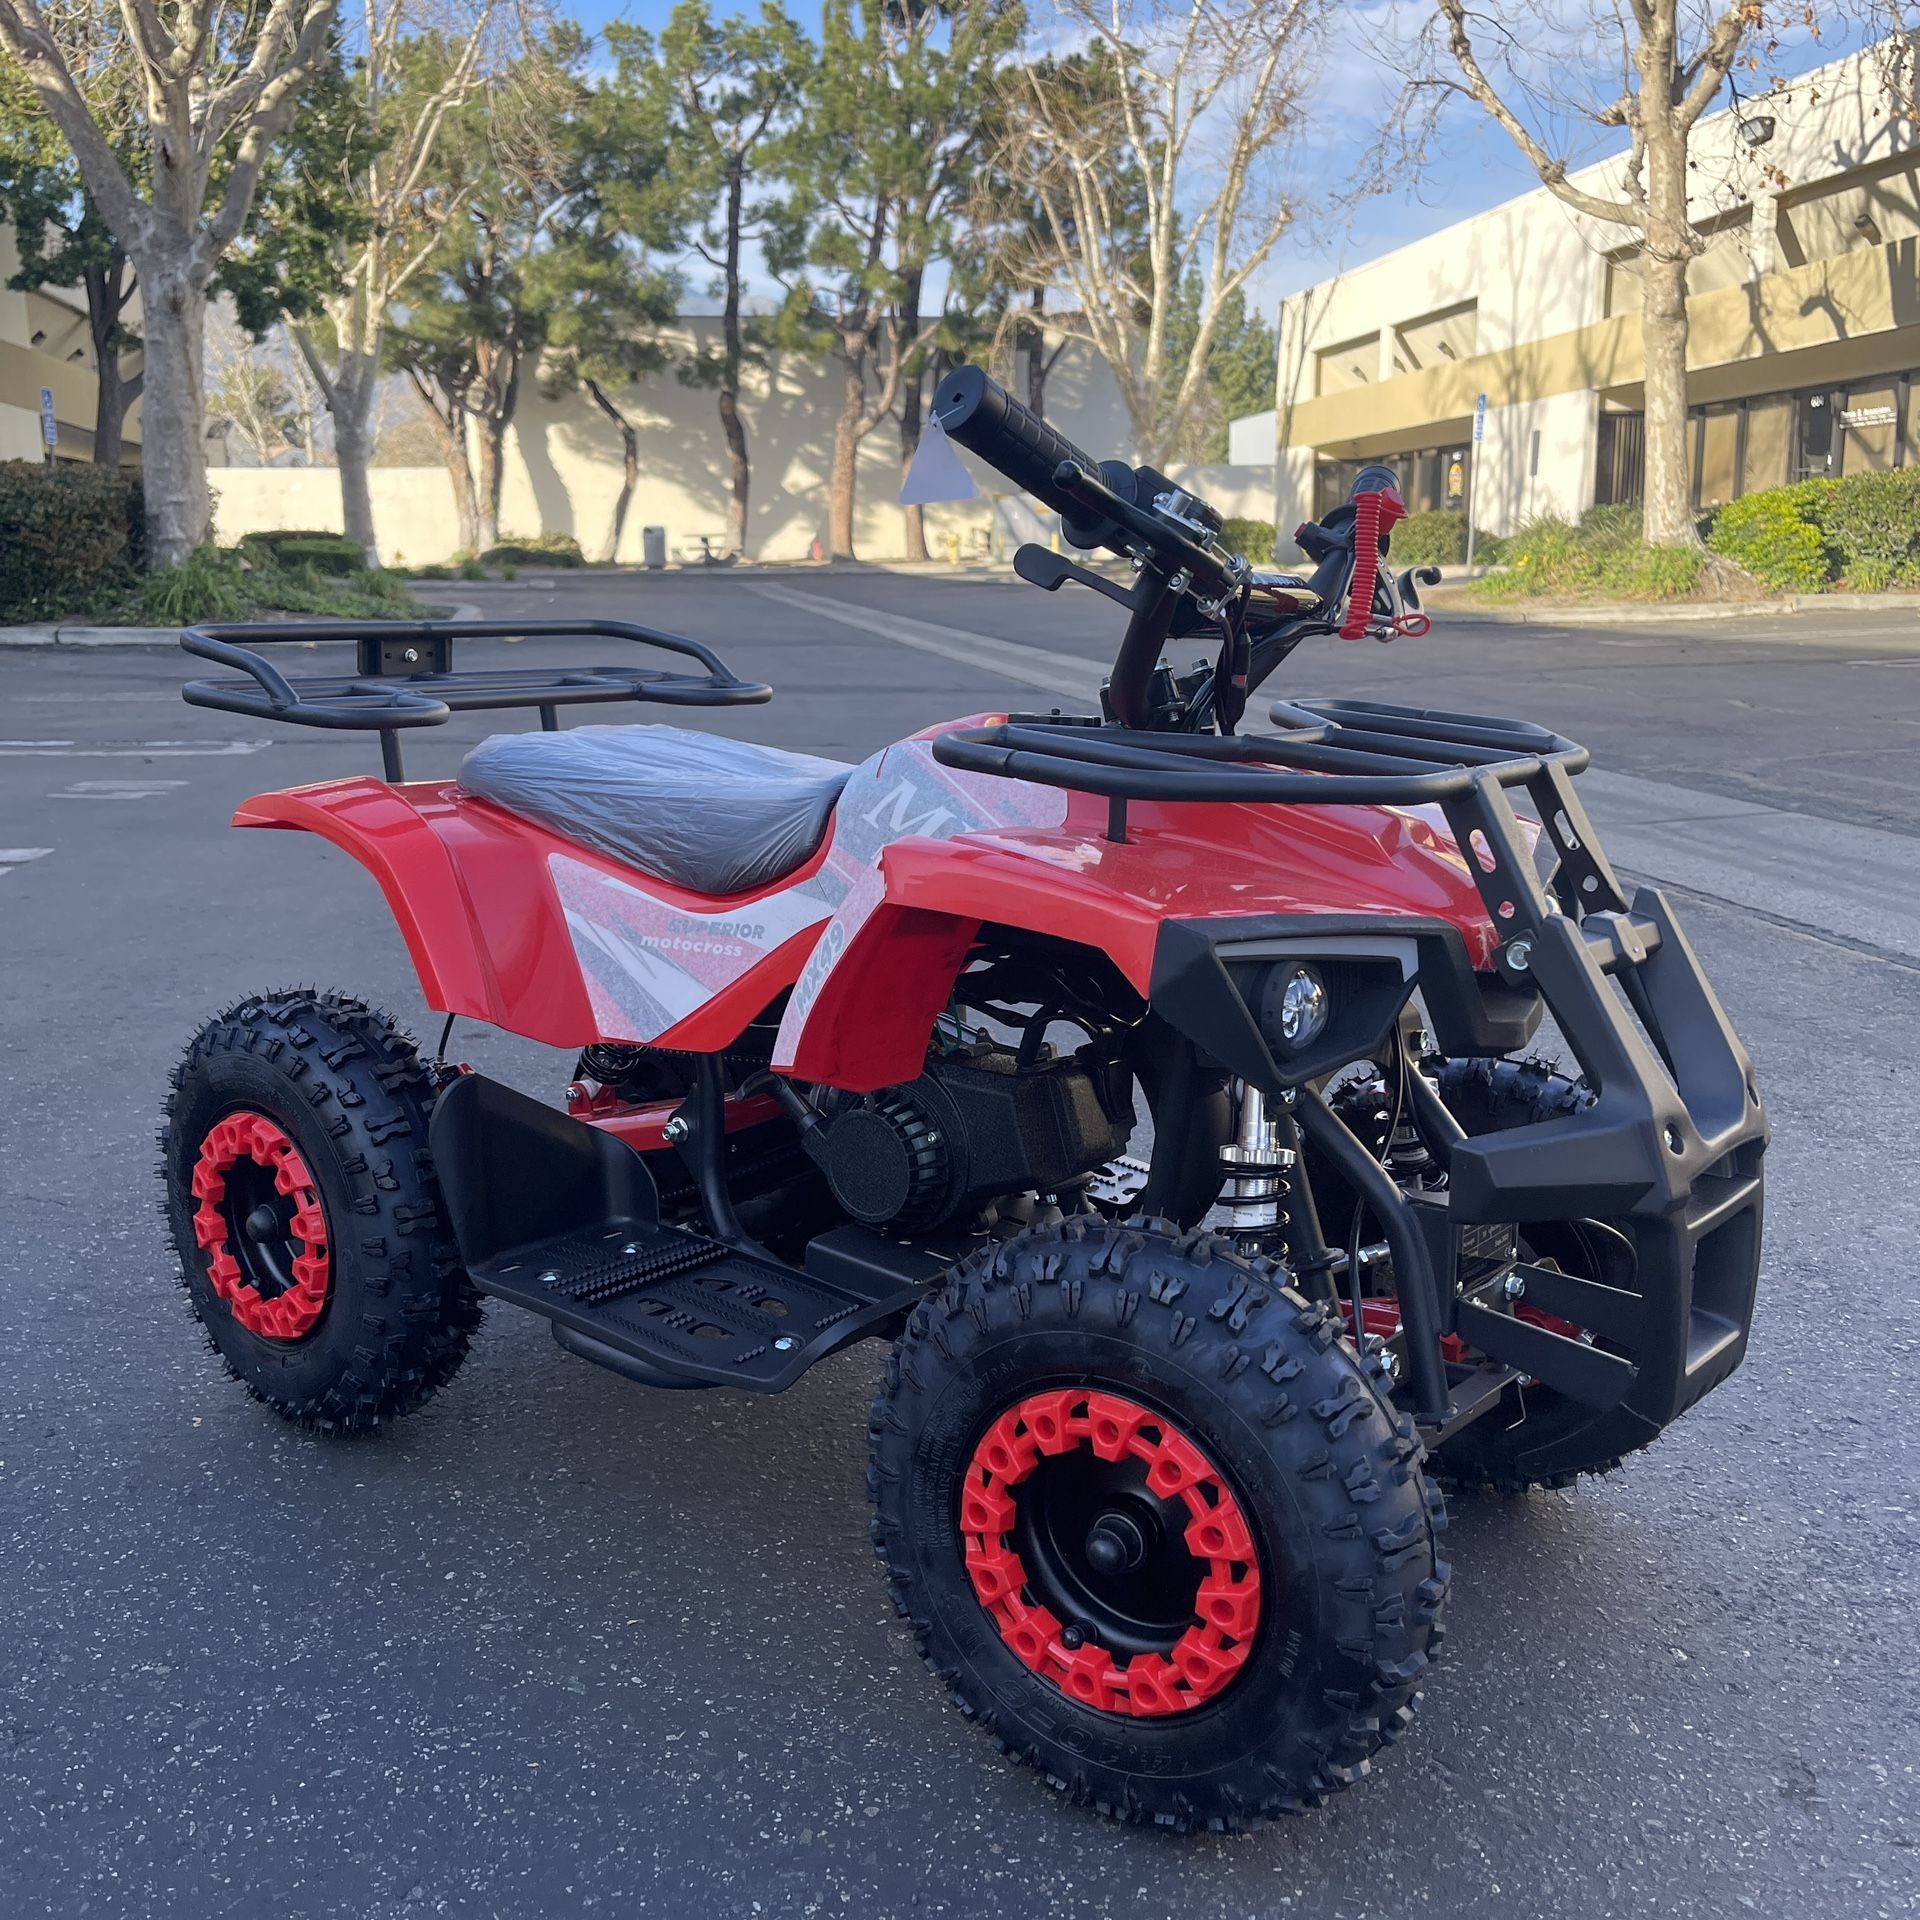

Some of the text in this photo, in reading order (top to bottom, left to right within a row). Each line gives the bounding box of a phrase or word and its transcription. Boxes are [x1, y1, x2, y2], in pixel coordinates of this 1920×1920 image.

[670, 918, 765, 940] SUPERIOR
[640, 935, 743, 957] motocross
[795, 921, 845, 1020] MX49
